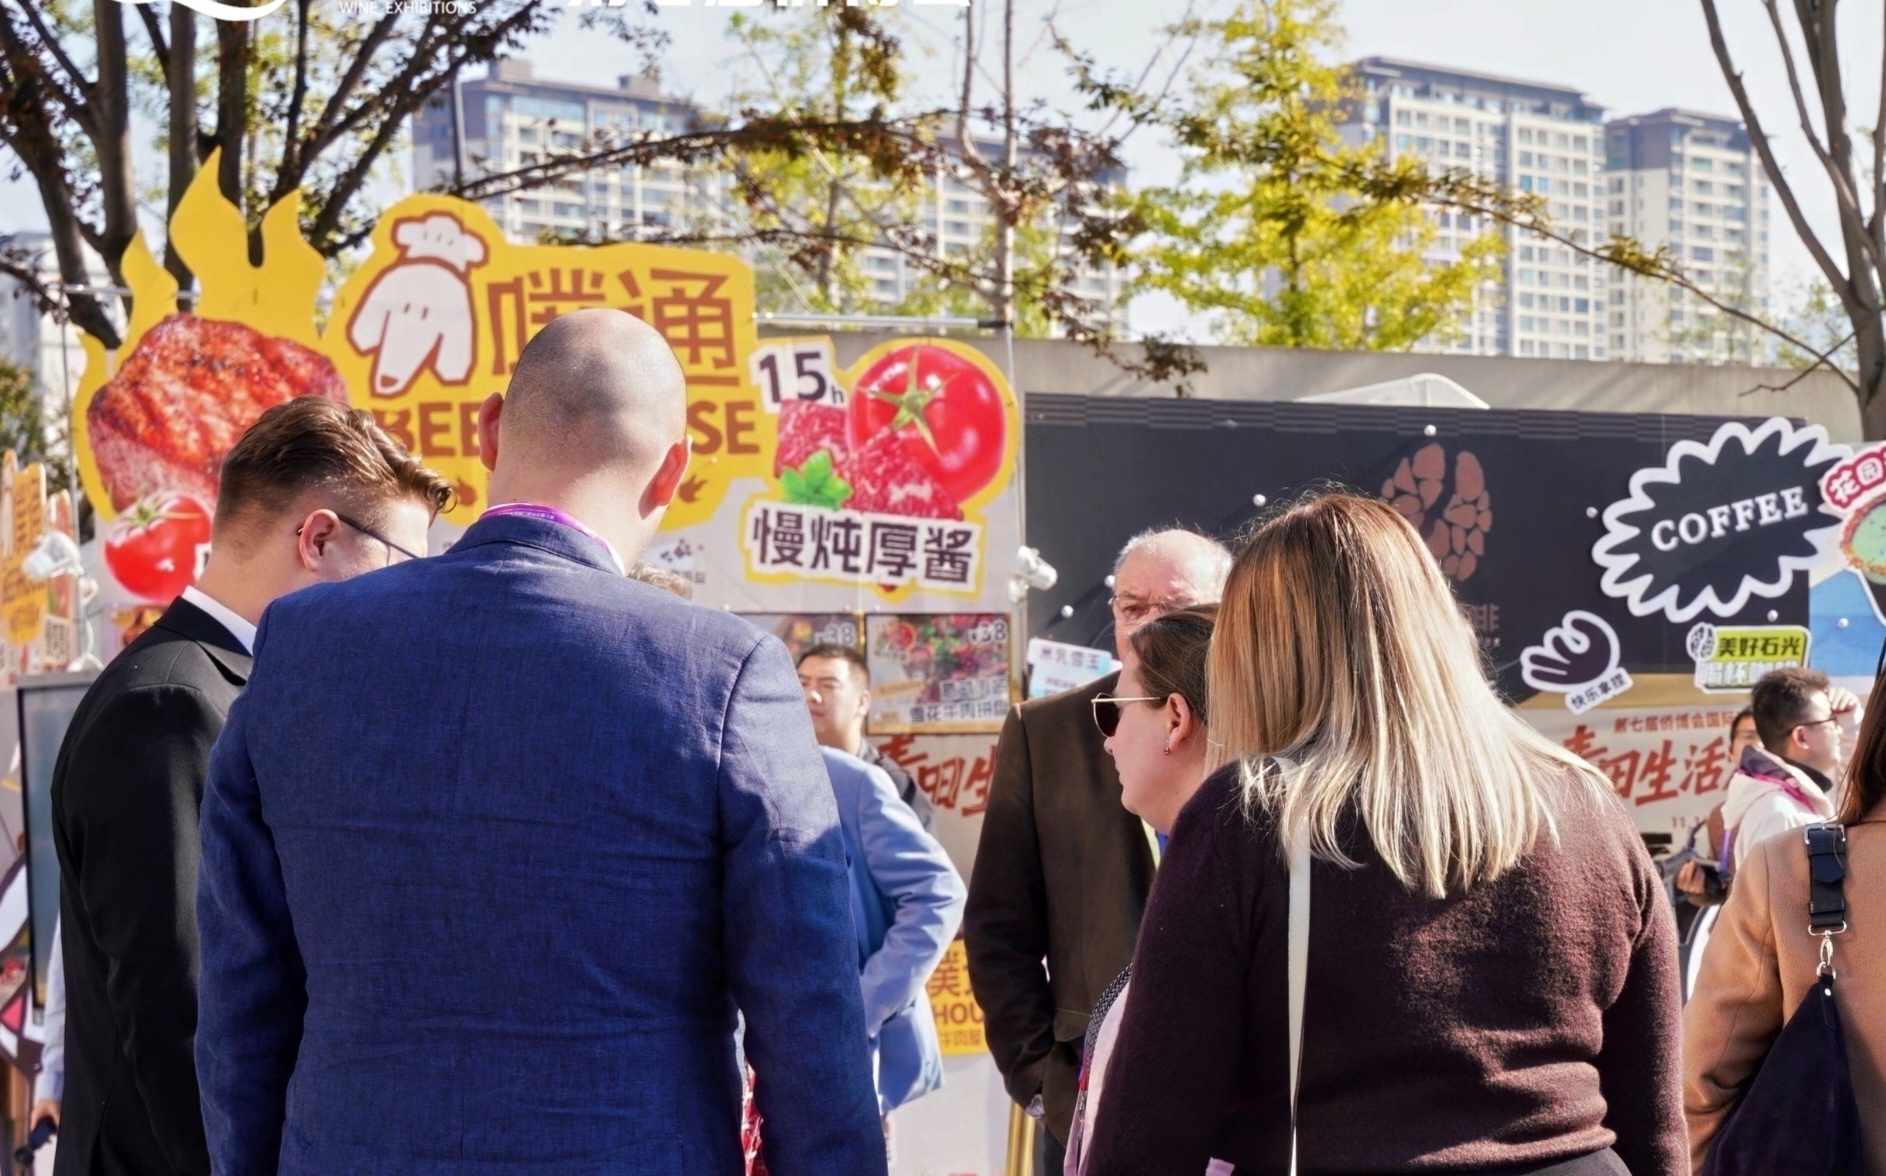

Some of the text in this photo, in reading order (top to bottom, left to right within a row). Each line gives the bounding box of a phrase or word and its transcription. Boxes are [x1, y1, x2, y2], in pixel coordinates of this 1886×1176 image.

[374, 402, 482, 457] BEE
[1651, 487, 1809, 552] COFFEE
[751, 509, 974, 586] 慢炖厚酱
[1719, 636, 1800, 657] 美好石光
[932, 1001, 985, 1025] HOU
